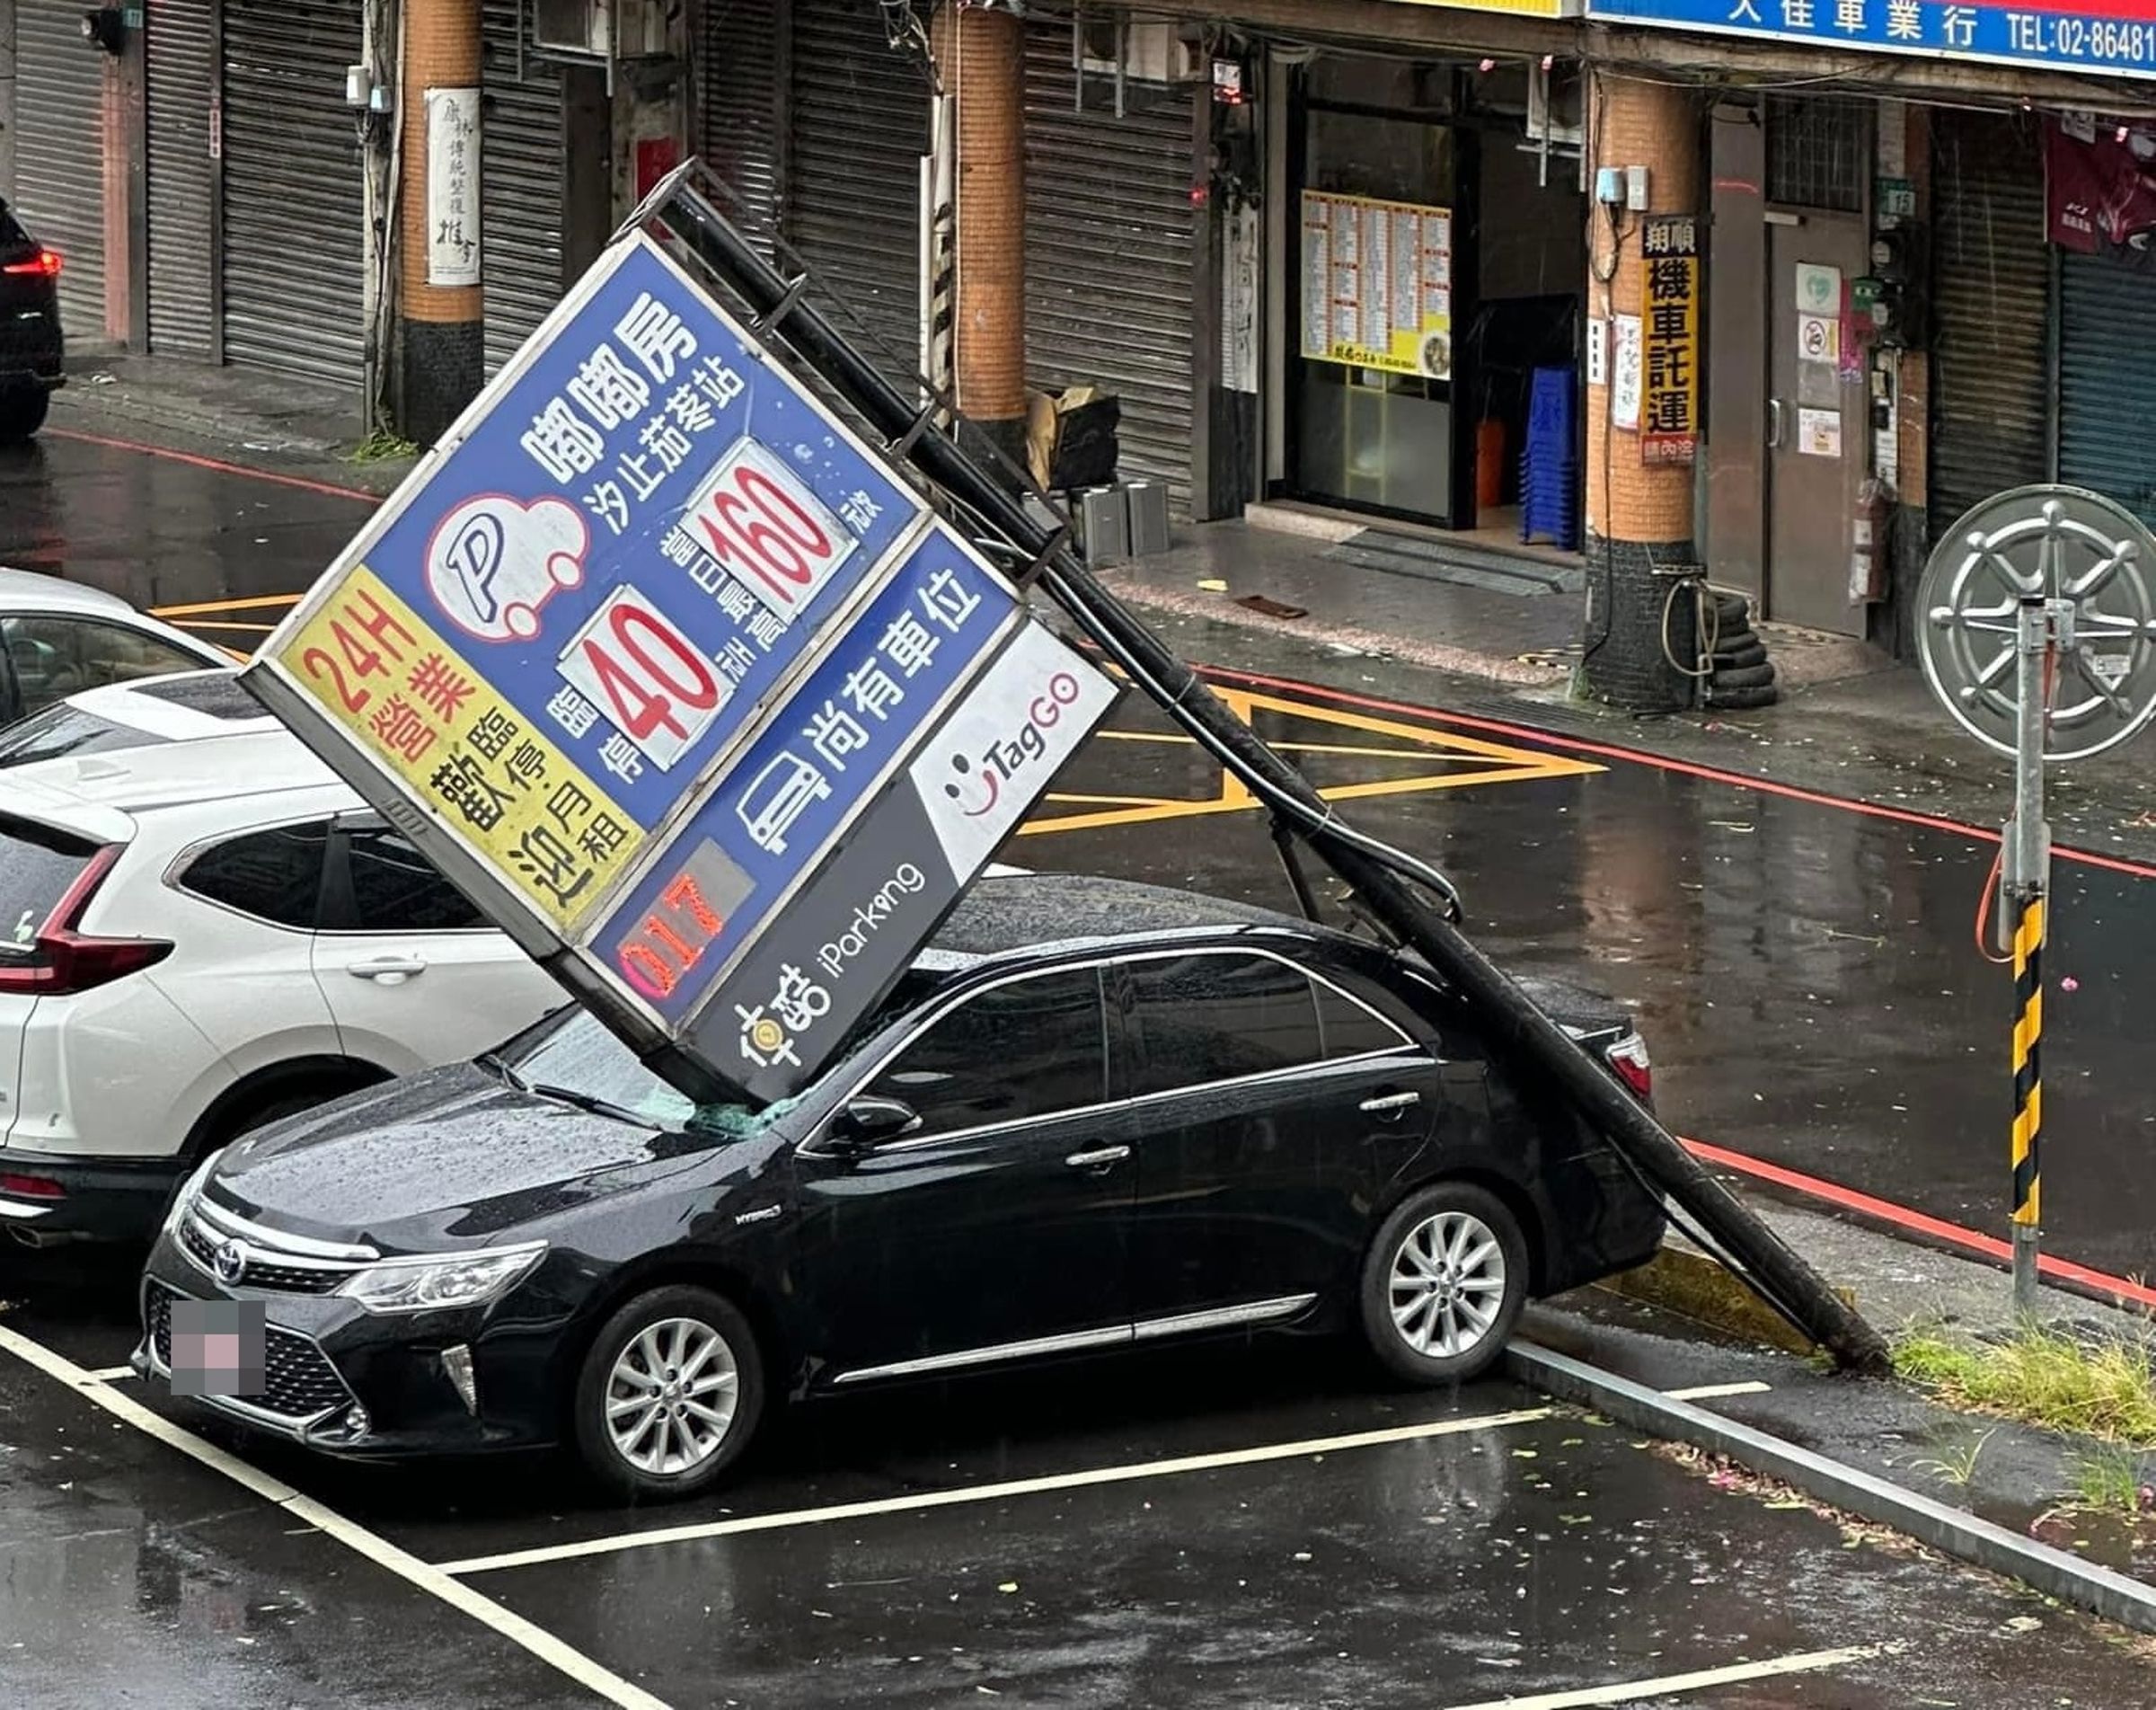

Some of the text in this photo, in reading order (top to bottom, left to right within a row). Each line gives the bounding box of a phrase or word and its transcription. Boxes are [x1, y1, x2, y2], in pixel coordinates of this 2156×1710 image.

[519, 292, 698, 484] 嘟嘟房
[1648, 258, 1691, 433] 機車託運
[582, 355, 746, 536] 汐止茄苳站
[658, 526, 788, 651] 當日最高
[698, 466, 832, 605] 160
[303, 589, 417, 714] 24H
[369, 653, 476, 763] 營業
[584, 603, 717, 741] 40
[802, 568, 982, 771] 尚有車位
[545, 685, 644, 784] 臨停
[983, 671, 1079, 782] TagGO
[429, 741, 594, 908] 歡迎
[620, 872, 722, 1001] 017
